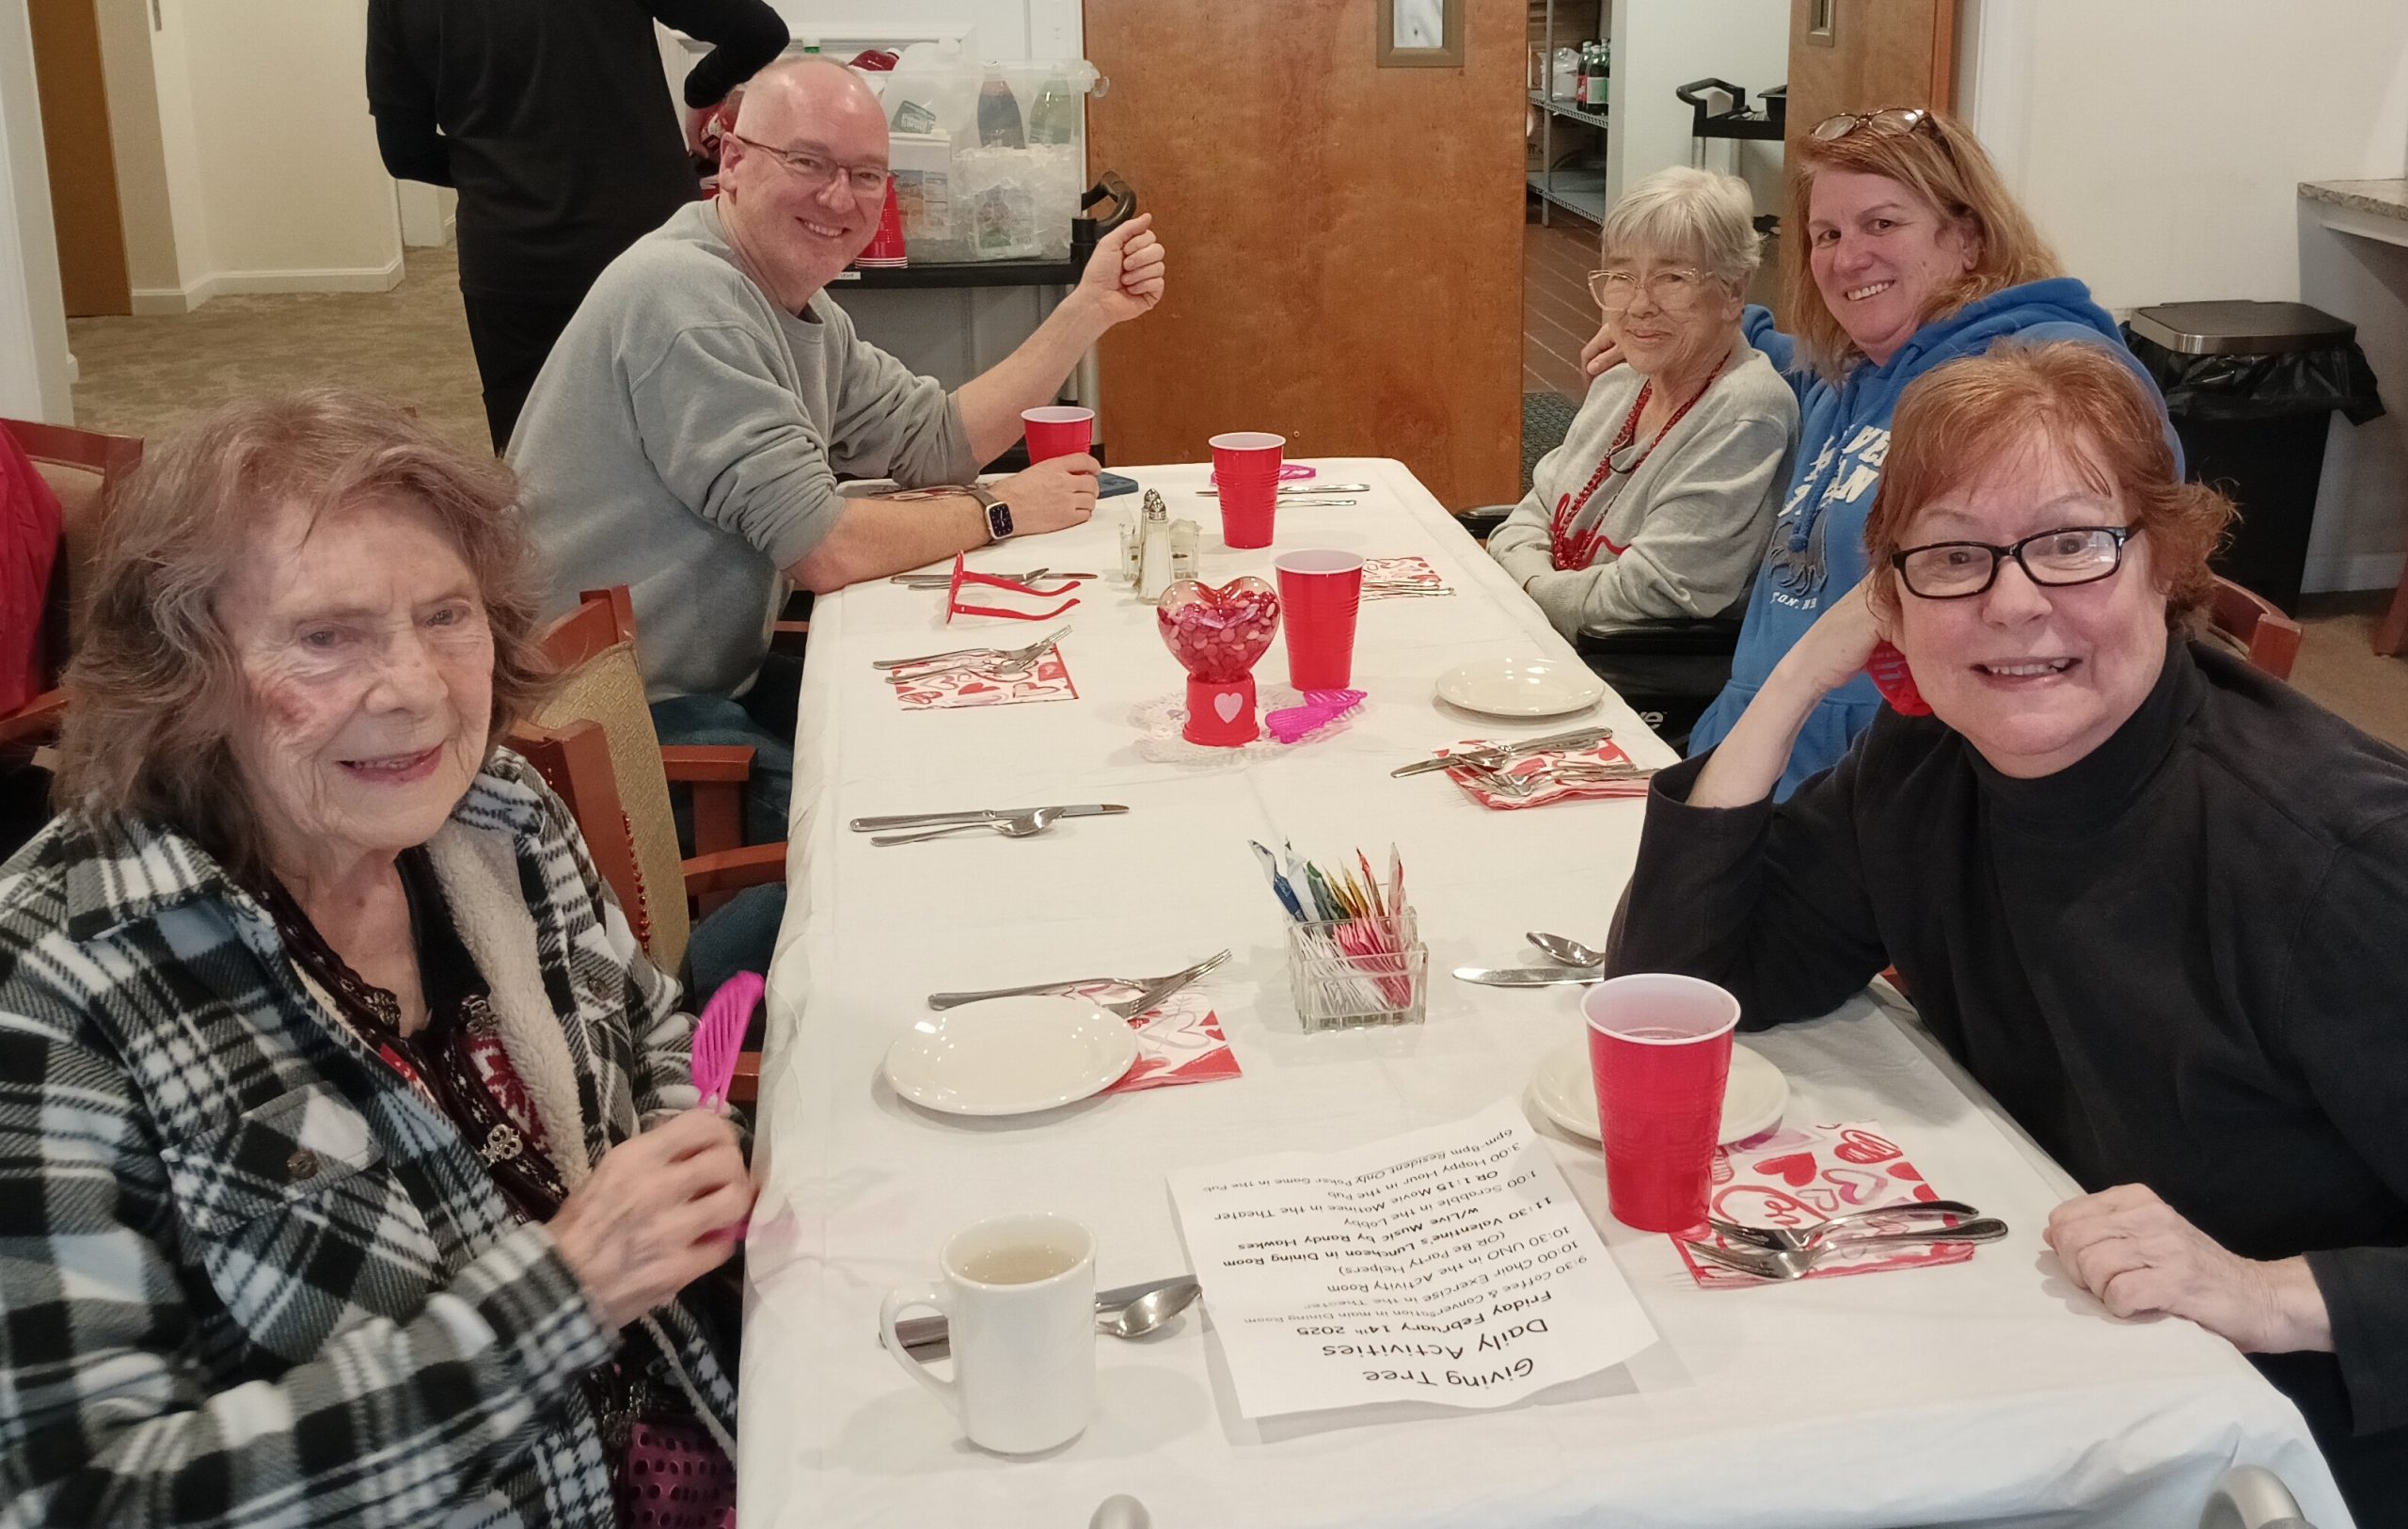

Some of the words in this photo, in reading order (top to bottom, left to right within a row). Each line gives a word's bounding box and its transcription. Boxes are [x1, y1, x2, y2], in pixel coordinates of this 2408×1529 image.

[1450, 1129, 1513, 1156] 6pm-8pm
[1490, 1142, 1520, 1162] 3:00
[1390, 1152, 1445, 1174] Resident
[1442, 1157, 1486, 1172] Happy
[1317, 1178, 1353, 1187] Poker
[1356, 1171, 1385, 1184] Only
[1403, 1171, 1437, 1185] Hour
[1475, 1171, 1497, 1181] OR
[1507, 1171, 1536, 1187] 1:00
[1386, 1183, 1398, 1192] in
[1437, 1177, 1471, 1191] 1:15
[1327, 1191, 1353, 1201] Pub
[1356, 1188, 1381, 1200] the
[1390, 1187, 1431, 1204] Movie
[1437, 1184, 1501, 1207] Scrabble
[1213, 1208, 1275, 1221] Theater
[1309, 1204, 1323, 1213] in
[1327, 1202, 1385, 1213] Matinee
[1390, 1208, 1415, 1220] the
[1509, 1197, 1551, 1219] 11:30
[1344, 1218, 1386, 1229] Lobby
[1430, 1208, 1479, 1225] w/Live
[1304, 1234, 1350, 1245] Randy
[1356, 1233, 1374, 1243] by
[1381, 1223, 1422, 1242] Music
[1420, 1218, 1503, 1246] Valentine's
[1477, 1231, 1505, 1246] (OR
[1529, 1226, 1569, 1247] 10:30
[1238, 1238, 1296, 1250] Hawkes
[1345, 1243, 1415, 1258] Luncheon
[1452, 1243, 1471, 1253] Be
[1487, 1242, 1524, 1261] UNO
[1271, 1253, 1319, 1263] Dining
[1409, 1250, 1449, 1268] Party
[1468, 1255, 1482, 1265] in
[1538, 1241, 1577, 1264] 10:00
[1223, 1257, 1264, 1266] Room
[1494, 1259, 1532, 1278] Chair
[1556, 1256, 1587, 1274] 9:30
[1339, 1265, 1404, 1276] Helpers)
[1438, 1263, 1464, 1276] the
[1326, 1283, 1369, 1293] Room
[1373, 1273, 1433, 1290] Activity
[1422, 1274, 1489, 1302] Exercise
[1502, 1271, 1551, 1292] Coffee
[1488, 1289, 1497, 1298] &
[1304, 1298, 1368, 1310] Theater
[1392, 1295, 1483, 1317] Conversation
[1493, 1291, 1551, 1315] Friday
[1288, 1313, 1334, 1321] Dining
[1402, 1314, 1484, 1333] February
[1296, 1327, 1345, 1336] 2025
[1354, 1325, 1390, 1335] 14th
[1479, 1319, 1548, 1351] Daily
[1323, 1345, 1464, 1360] Activities
[1363, 1370, 1438, 1386] Tree
[1446, 1359, 1533, 1389] Giving
